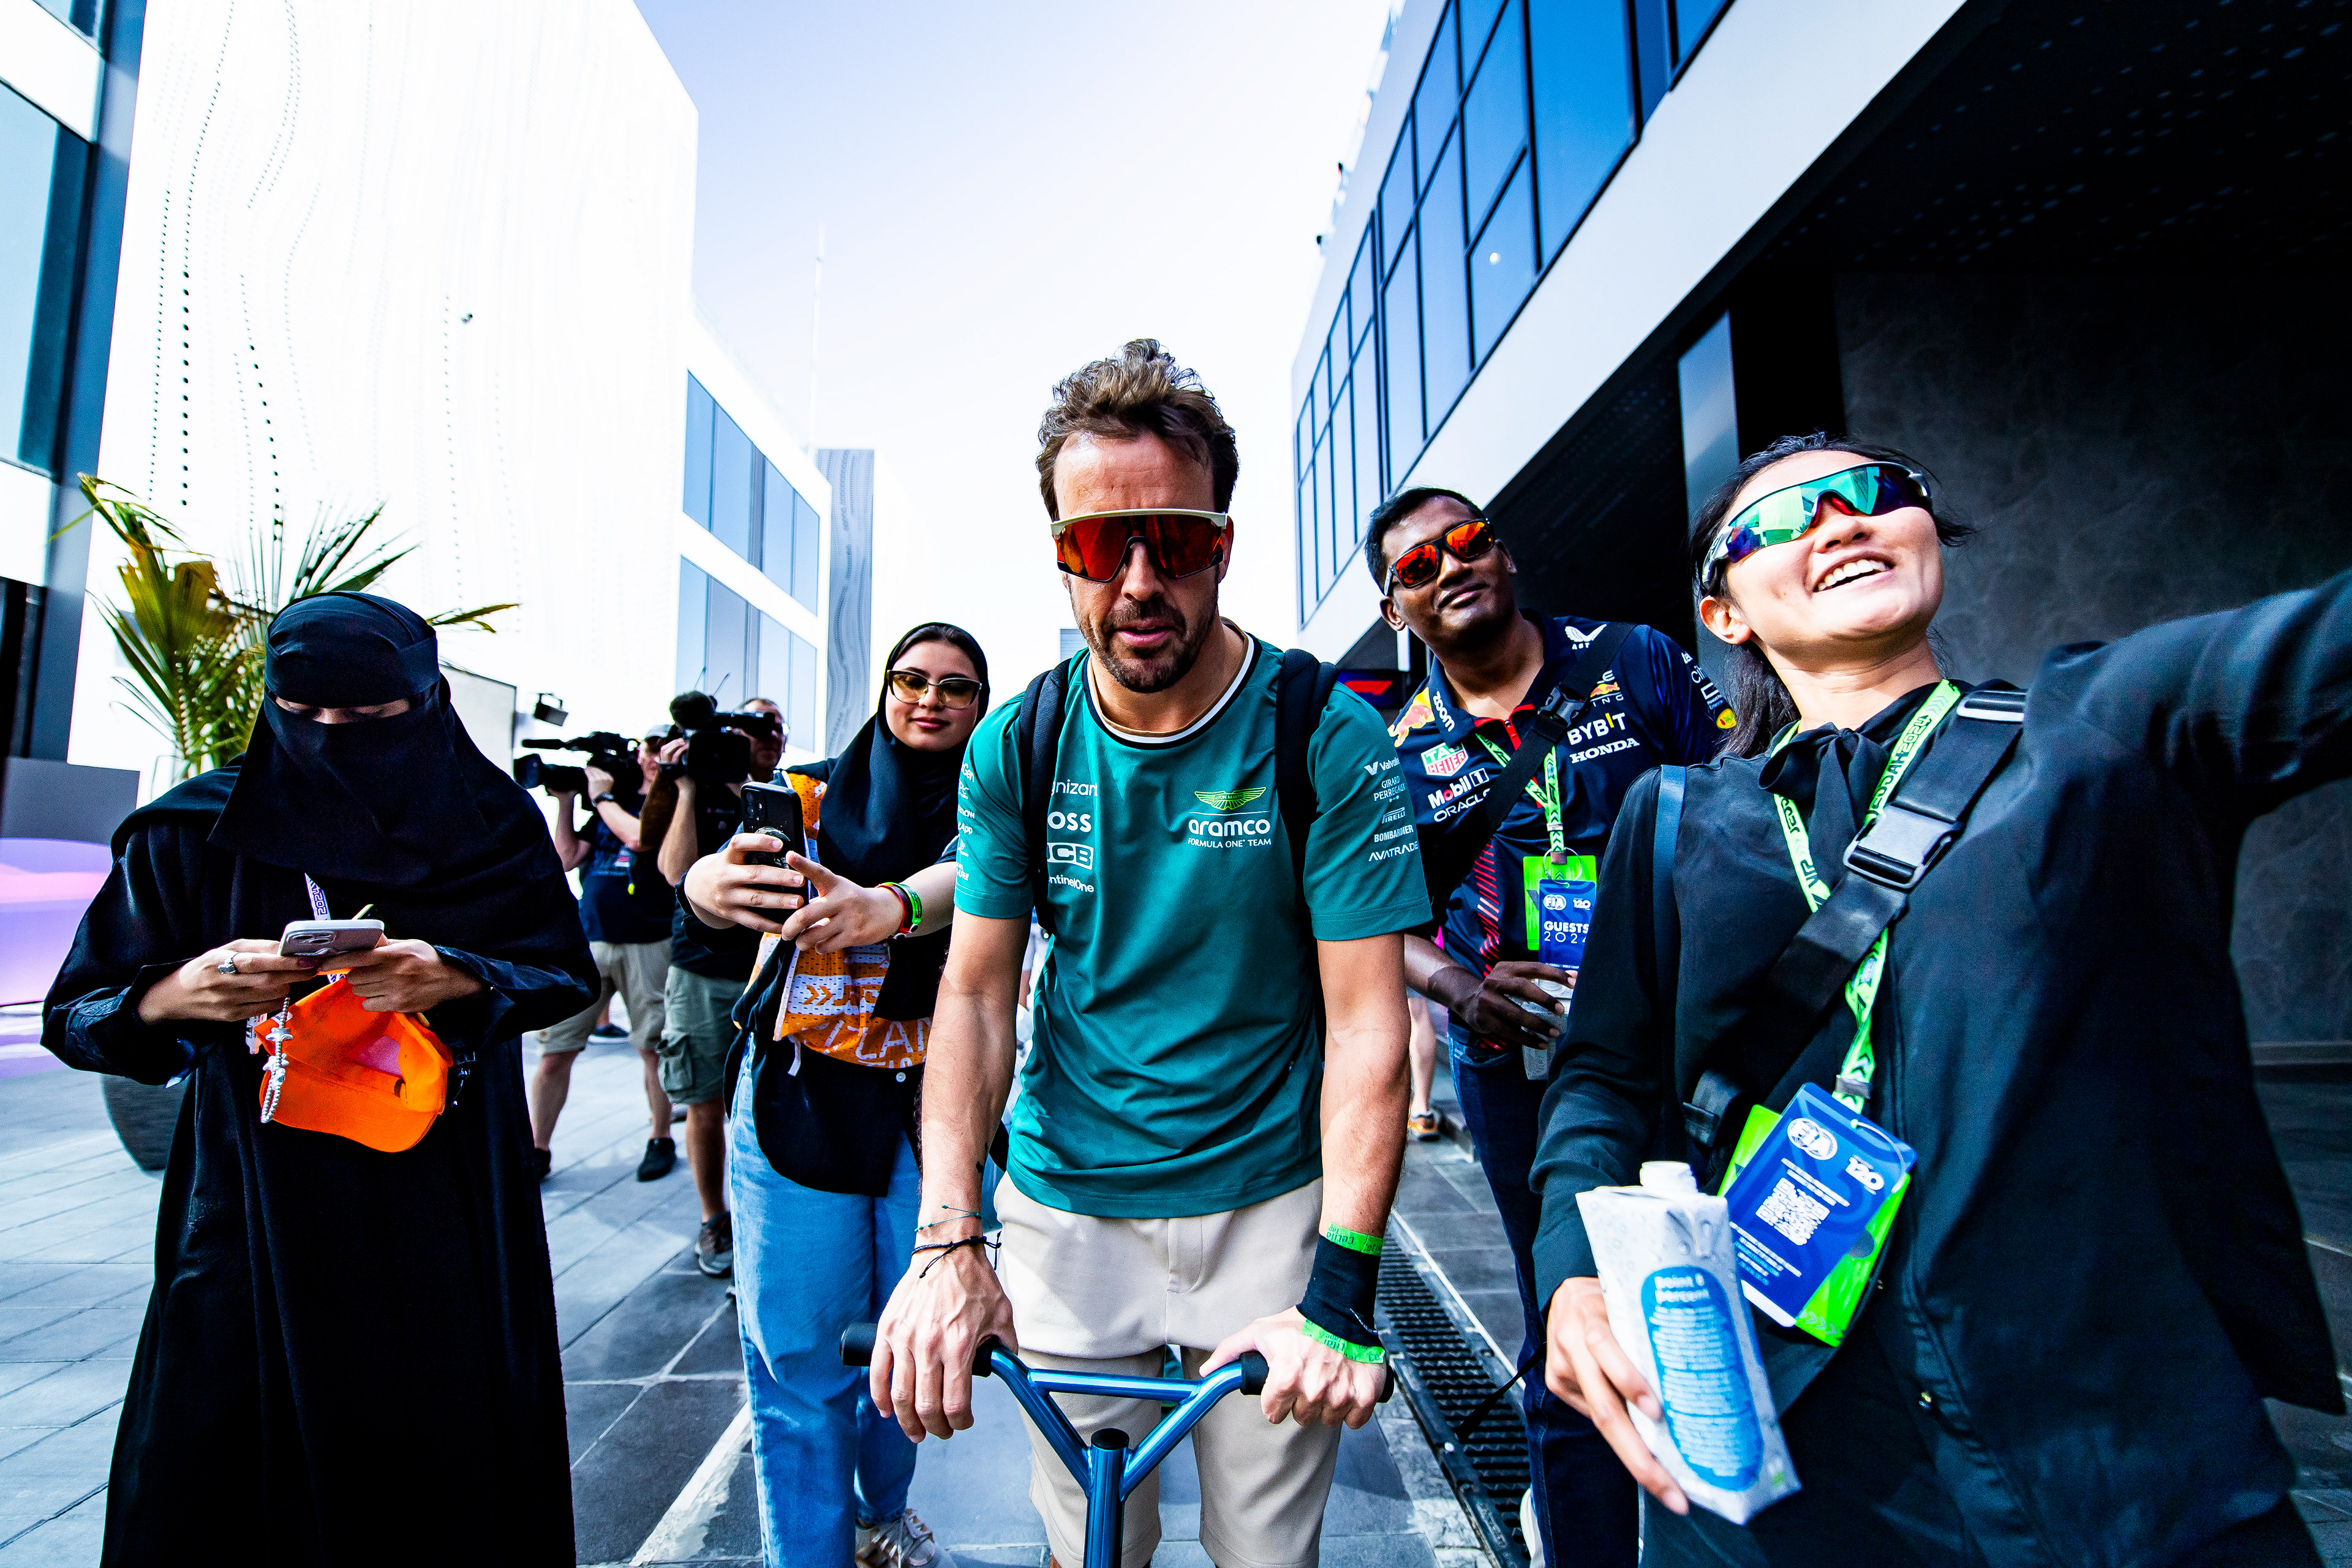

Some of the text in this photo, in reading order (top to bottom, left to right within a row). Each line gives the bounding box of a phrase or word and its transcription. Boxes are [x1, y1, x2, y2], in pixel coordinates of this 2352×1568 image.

[1593, 694, 1624, 707] ING
[1433, 690, 1455, 732] zoom
[1567, 712, 1626, 745] BYBIT
[1425, 744, 1460, 763] TA
[1569, 737, 1640, 764] HONDA
[1428, 752, 1466, 774] HEUER
[1382, 775, 1400, 788] GIRARD
[1374, 783, 1406, 801] PERREGAUX
[1428, 775, 1472, 809] Mobil
[1047, 812, 1091, 832] OSS
[1382, 807, 1405, 824] PIRELLI
[958, 821, 973, 835] tApp
[1188, 819, 1270, 837] aramco
[1374, 825, 1414, 843] BOMBARDIER
[1188, 838, 1223, 848] FORMULA
[1368, 841, 1419, 862] AVATRADE
[1047, 843, 1091, 867] CB
[1049, 875, 1094, 892] ntinelOne
[312, 884, 328, 915] 2024
[1544, 921, 1589, 934] GUESTS
[1326, 1232, 1354, 1245] Cetila
